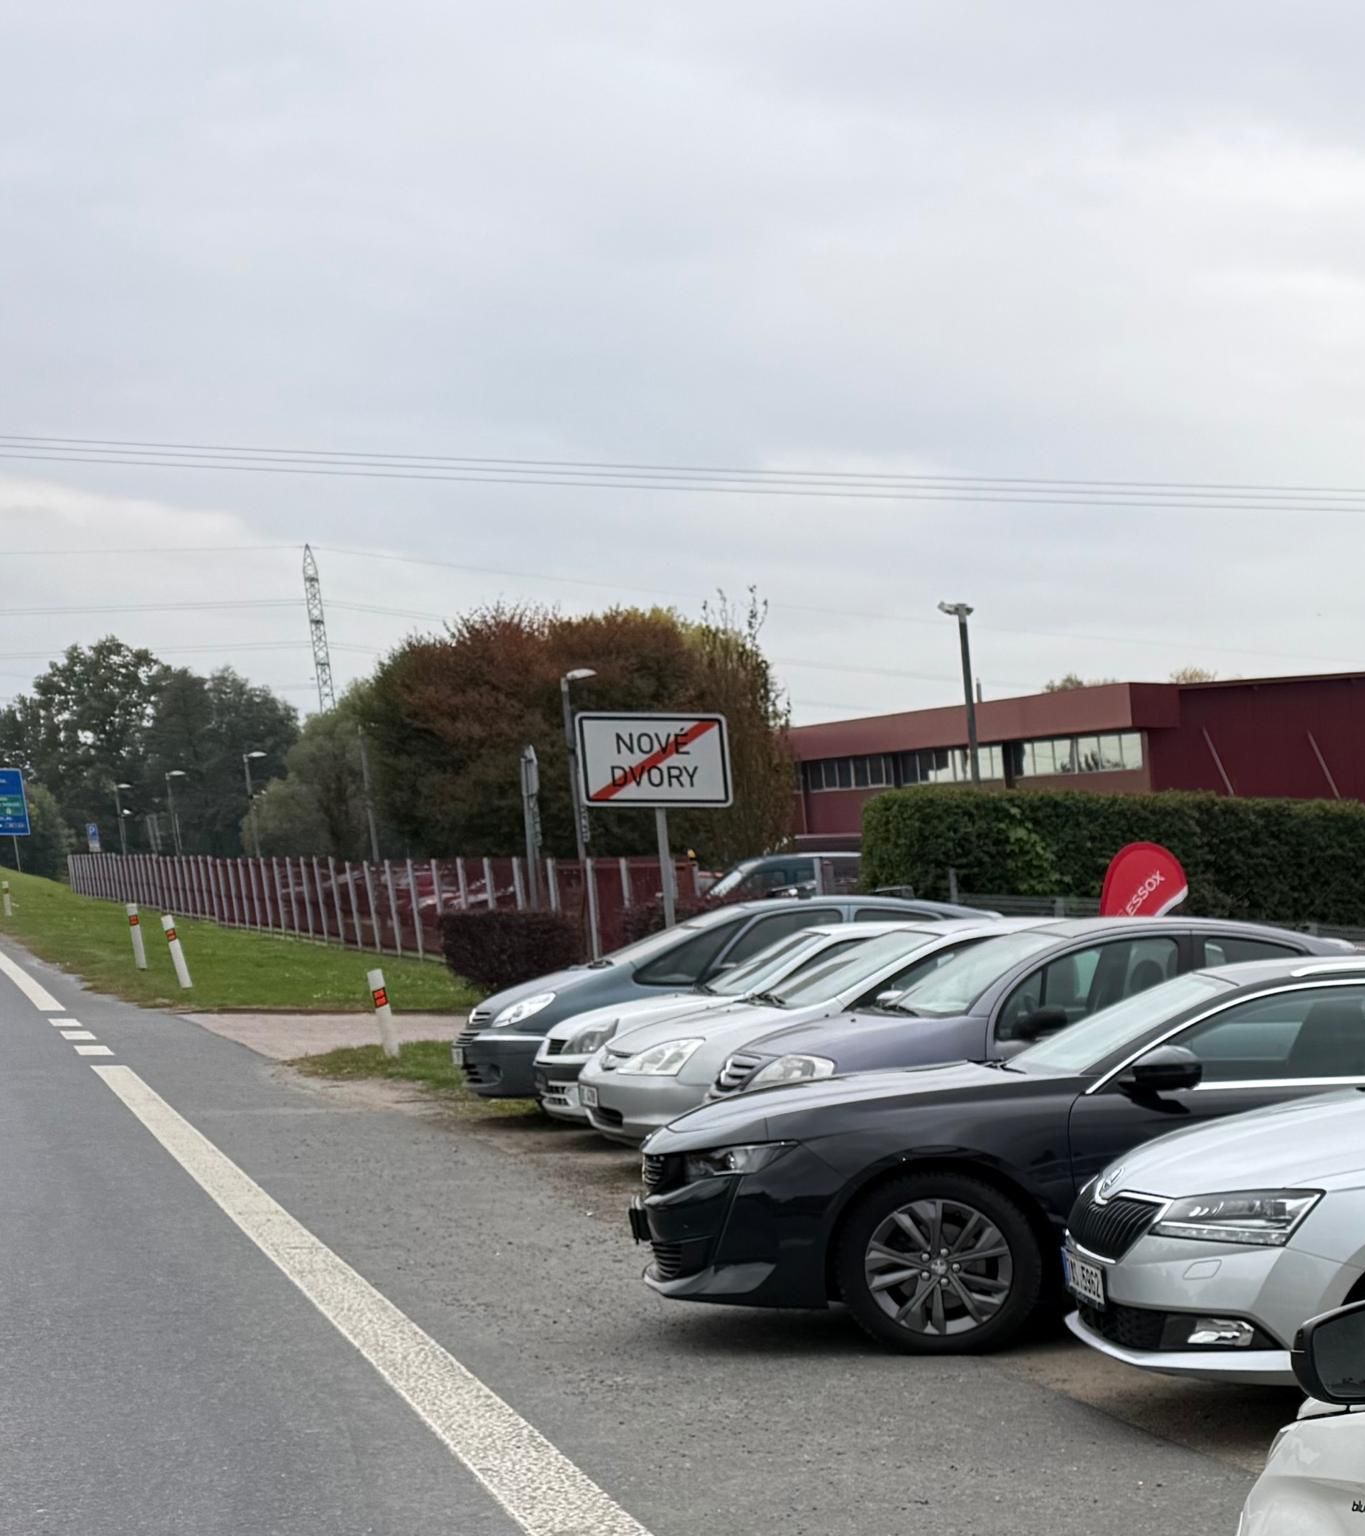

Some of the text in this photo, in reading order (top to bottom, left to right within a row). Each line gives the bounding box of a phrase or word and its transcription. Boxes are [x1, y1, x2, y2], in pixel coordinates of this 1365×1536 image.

[615, 727, 691, 755] NOVÉ
[610, 766, 699, 788] DVORY
[1126, 870, 1166, 917] ESSOX
